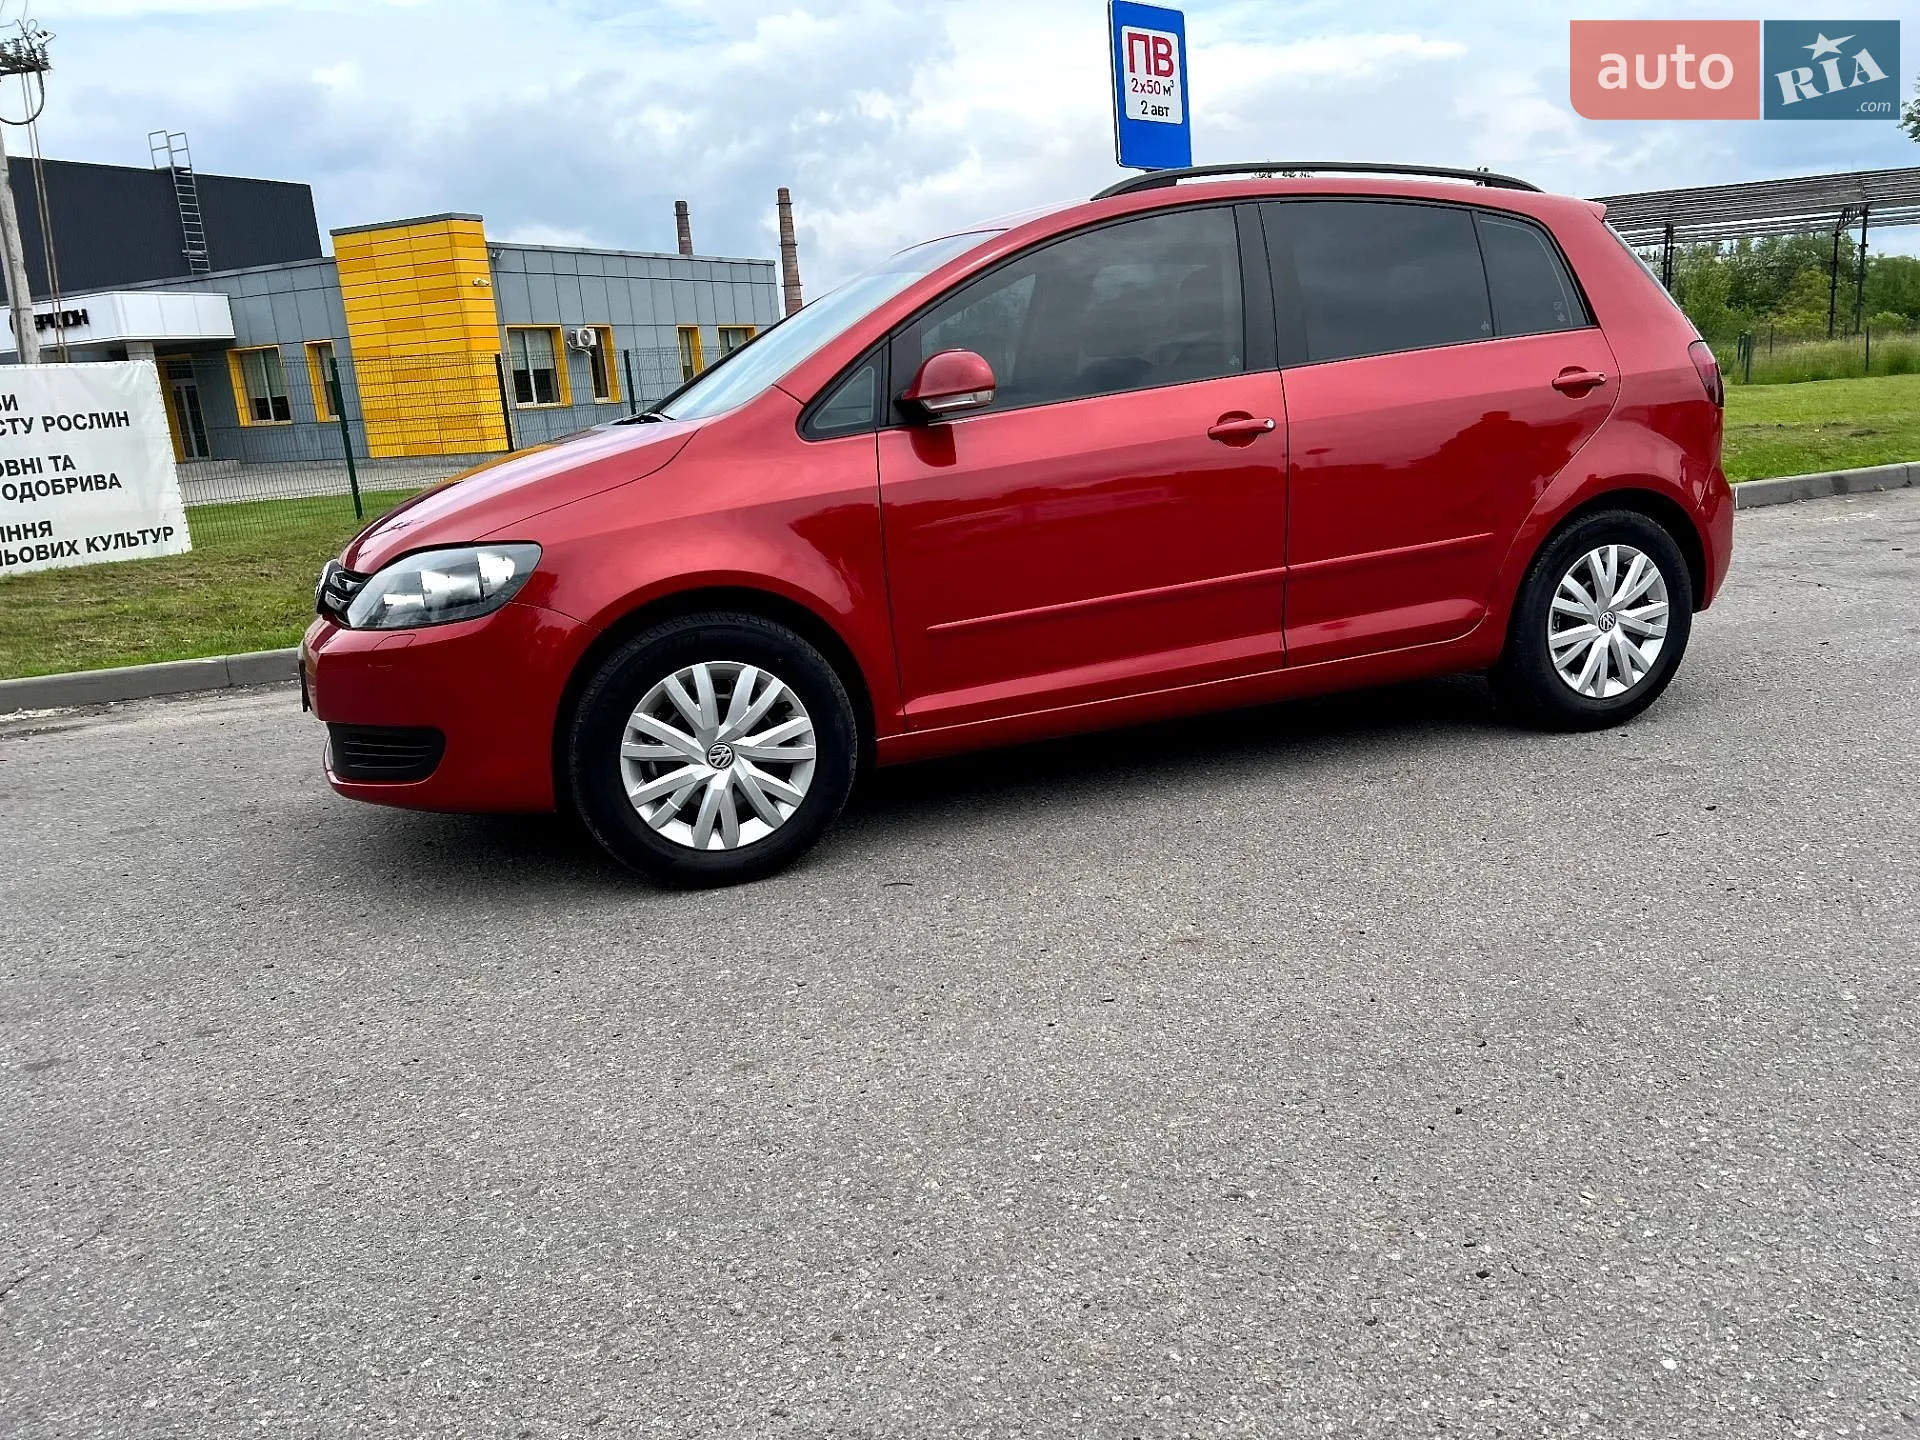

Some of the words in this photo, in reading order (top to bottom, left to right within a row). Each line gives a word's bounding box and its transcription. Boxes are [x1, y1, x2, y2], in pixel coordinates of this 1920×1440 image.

[1127, 32, 1174, 78] ПВ
[1140, 100, 1148, 115] 2
[1151, 105, 1170, 117] авт
[0, 393, 19, 412] И
[41, 410, 130, 433] РОСЛИН
[0, 457, 43, 478] ВНІ
[47, 454, 76, 472] ТА
[1, 473, 122, 504] ОДОБРИВА
[0, 539, 80, 567] ЬОВИХ
[86, 526, 174, 553] КУЛЬТУР
